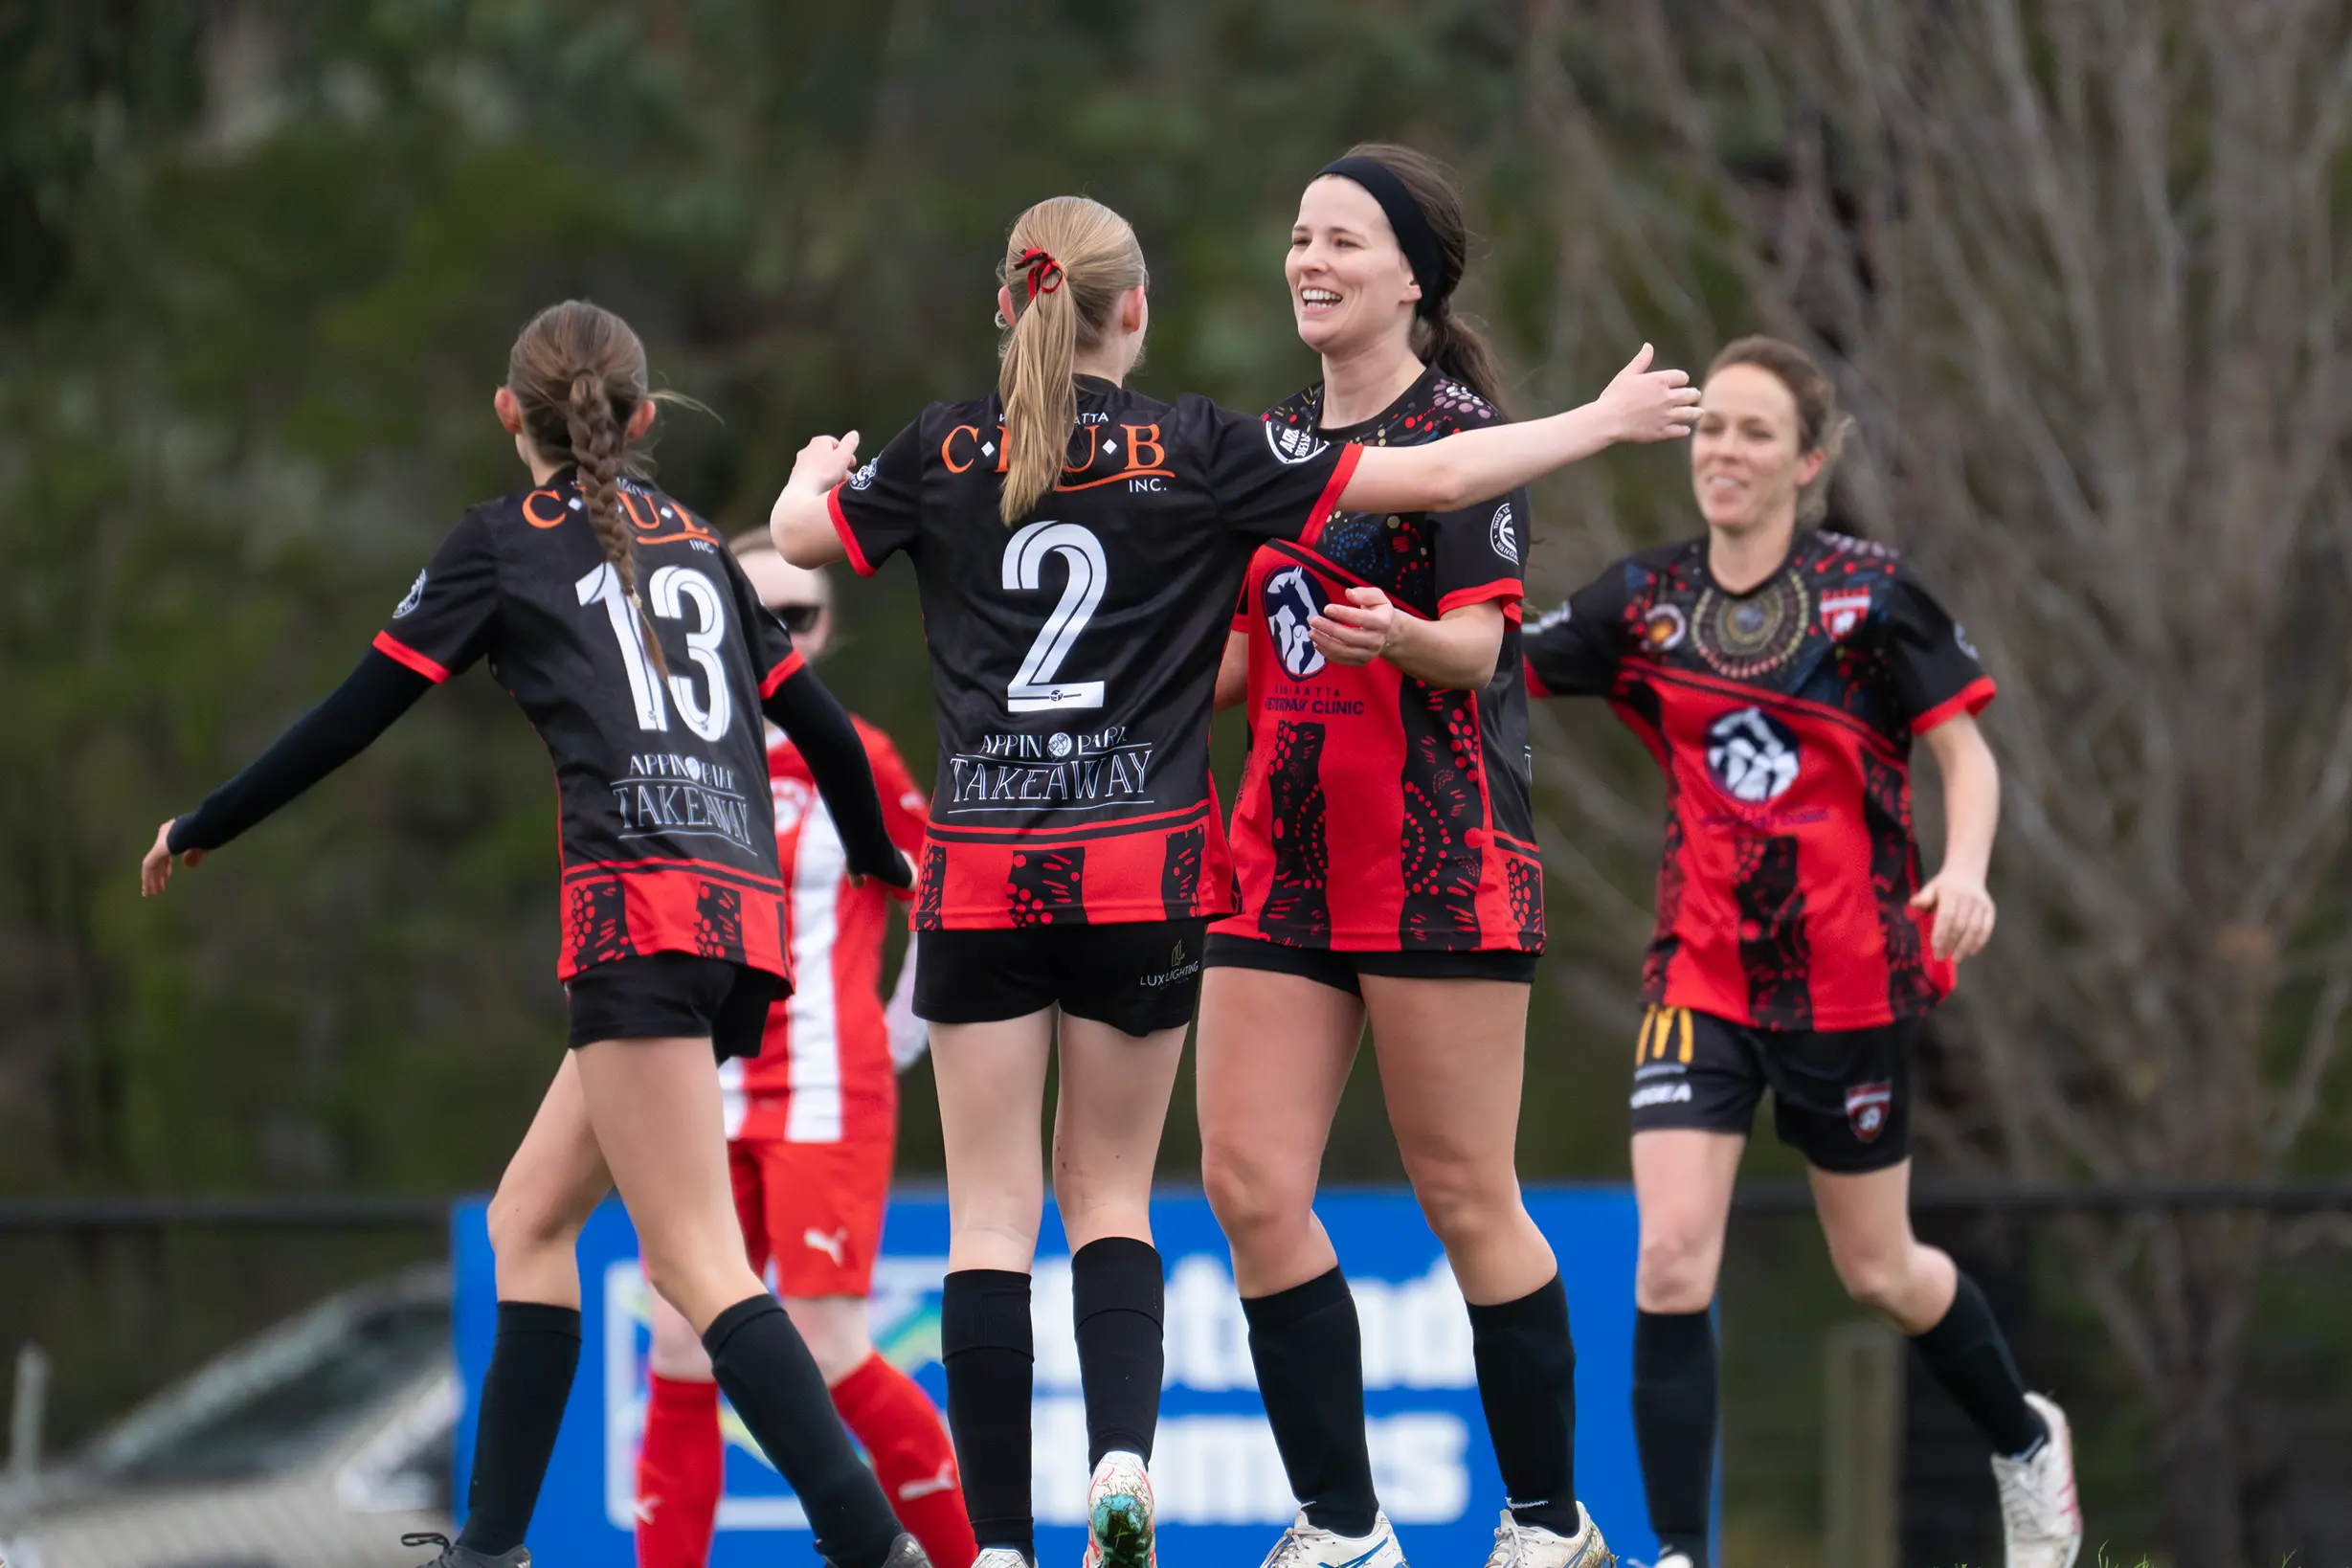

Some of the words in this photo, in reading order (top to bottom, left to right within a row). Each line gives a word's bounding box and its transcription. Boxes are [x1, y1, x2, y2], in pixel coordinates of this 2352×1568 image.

[1001, 520, 1108, 712] 2
[574, 561, 731, 743] 13
[1311, 700, 1365, 715] CLINIC
[629, 753, 688, 776] APPIN
[979, 734, 1042, 758] APPIN
[950, 750, 1153, 802] TAKEAWAY
[612, 785, 750, 845] TAKEAWAY
